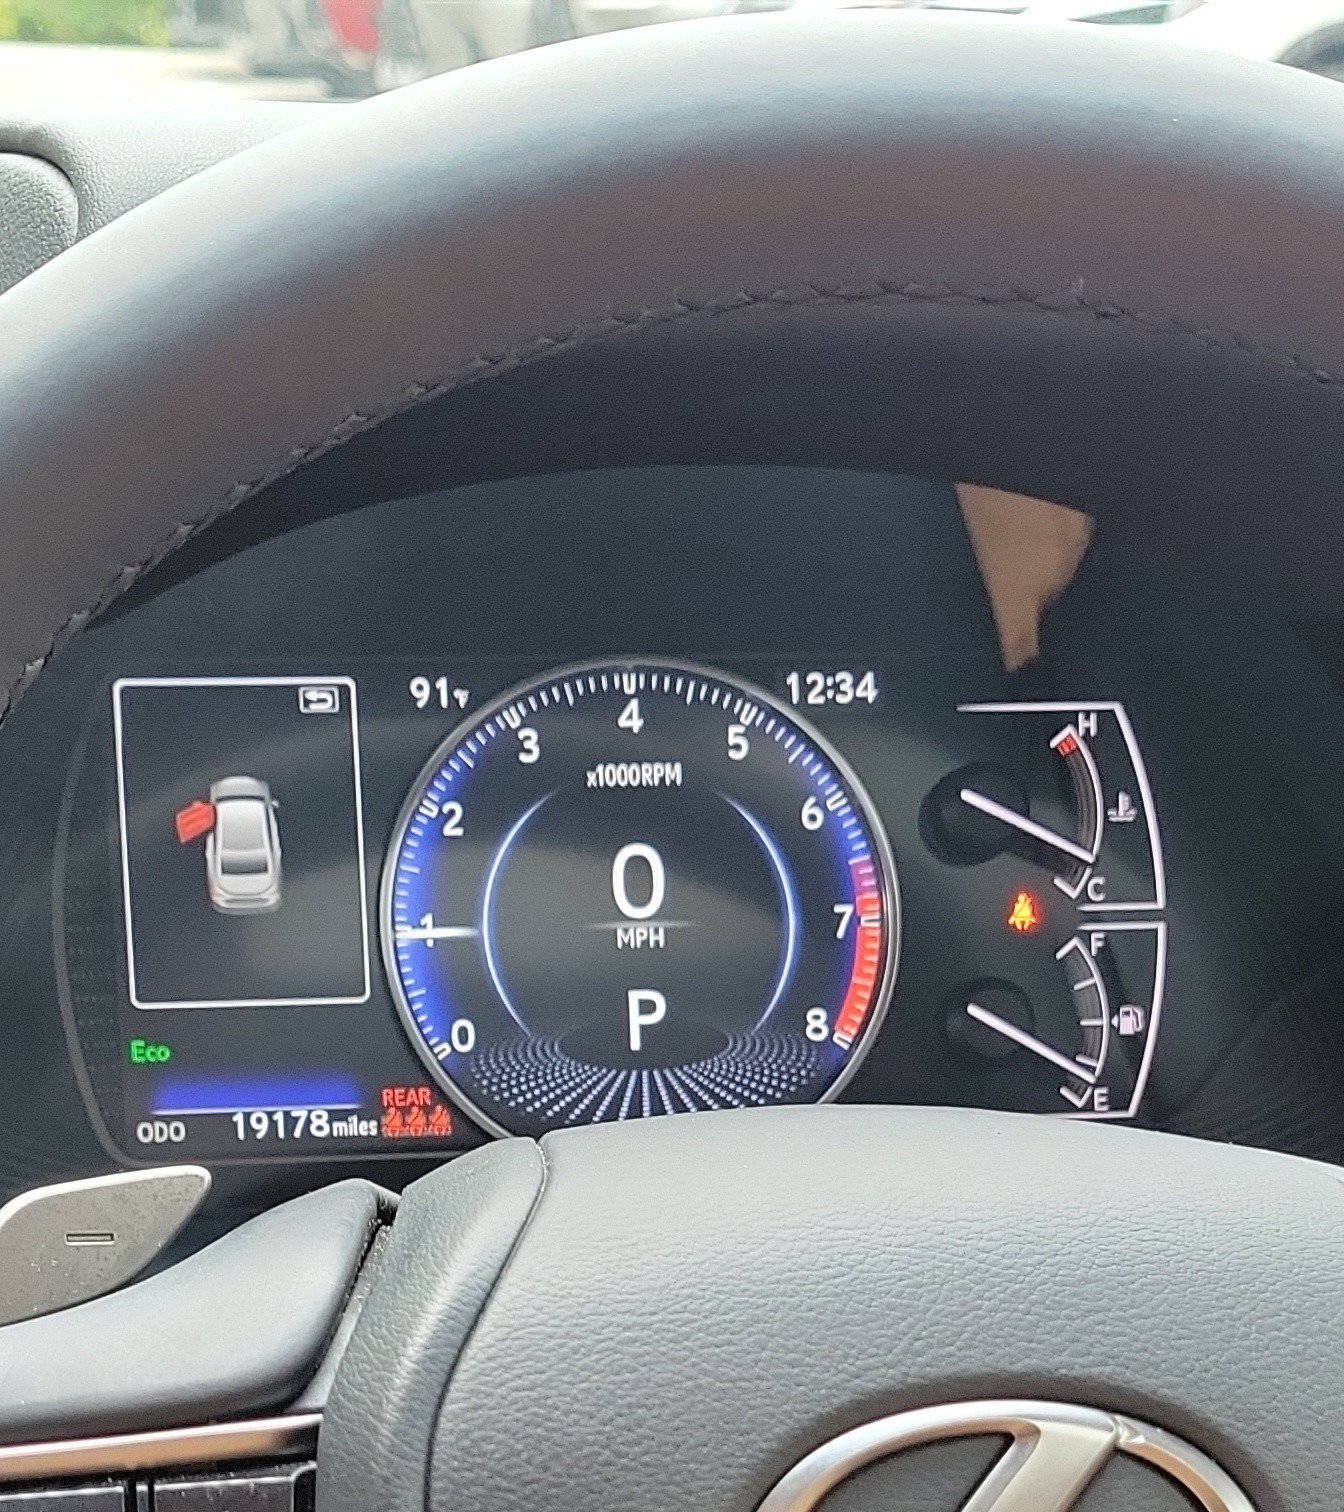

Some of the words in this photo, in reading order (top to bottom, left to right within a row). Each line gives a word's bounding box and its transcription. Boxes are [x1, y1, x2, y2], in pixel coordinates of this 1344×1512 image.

[786, 670, 878, 706] 12:34
[617, 698, 644, 734] 4
[1077, 712, 1098, 738] H
[517, 729, 541, 764] 3
[727, 726, 749, 761] 5
[586, 761, 683, 789] x1000RPM
[442, 802, 465, 837] 2
[801, 796, 824, 831] 6
[611, 842, 667, 919] 0
[1087, 877, 1106, 902] C
[616, 928, 665, 950] MPH
[832, 904, 853, 940] 7
[1090, 932, 1105, 956] F
[450, 1019, 475, 1053] 0
[628, 989, 667, 1051] P
[805, 1007, 829, 1042] 8
[131, 1040, 171, 1063] Eco
[381, 1087, 432, 1107] REAR
[1093, 1088, 1109, 1112] E
[136, 1120, 186, 1144] ODO
